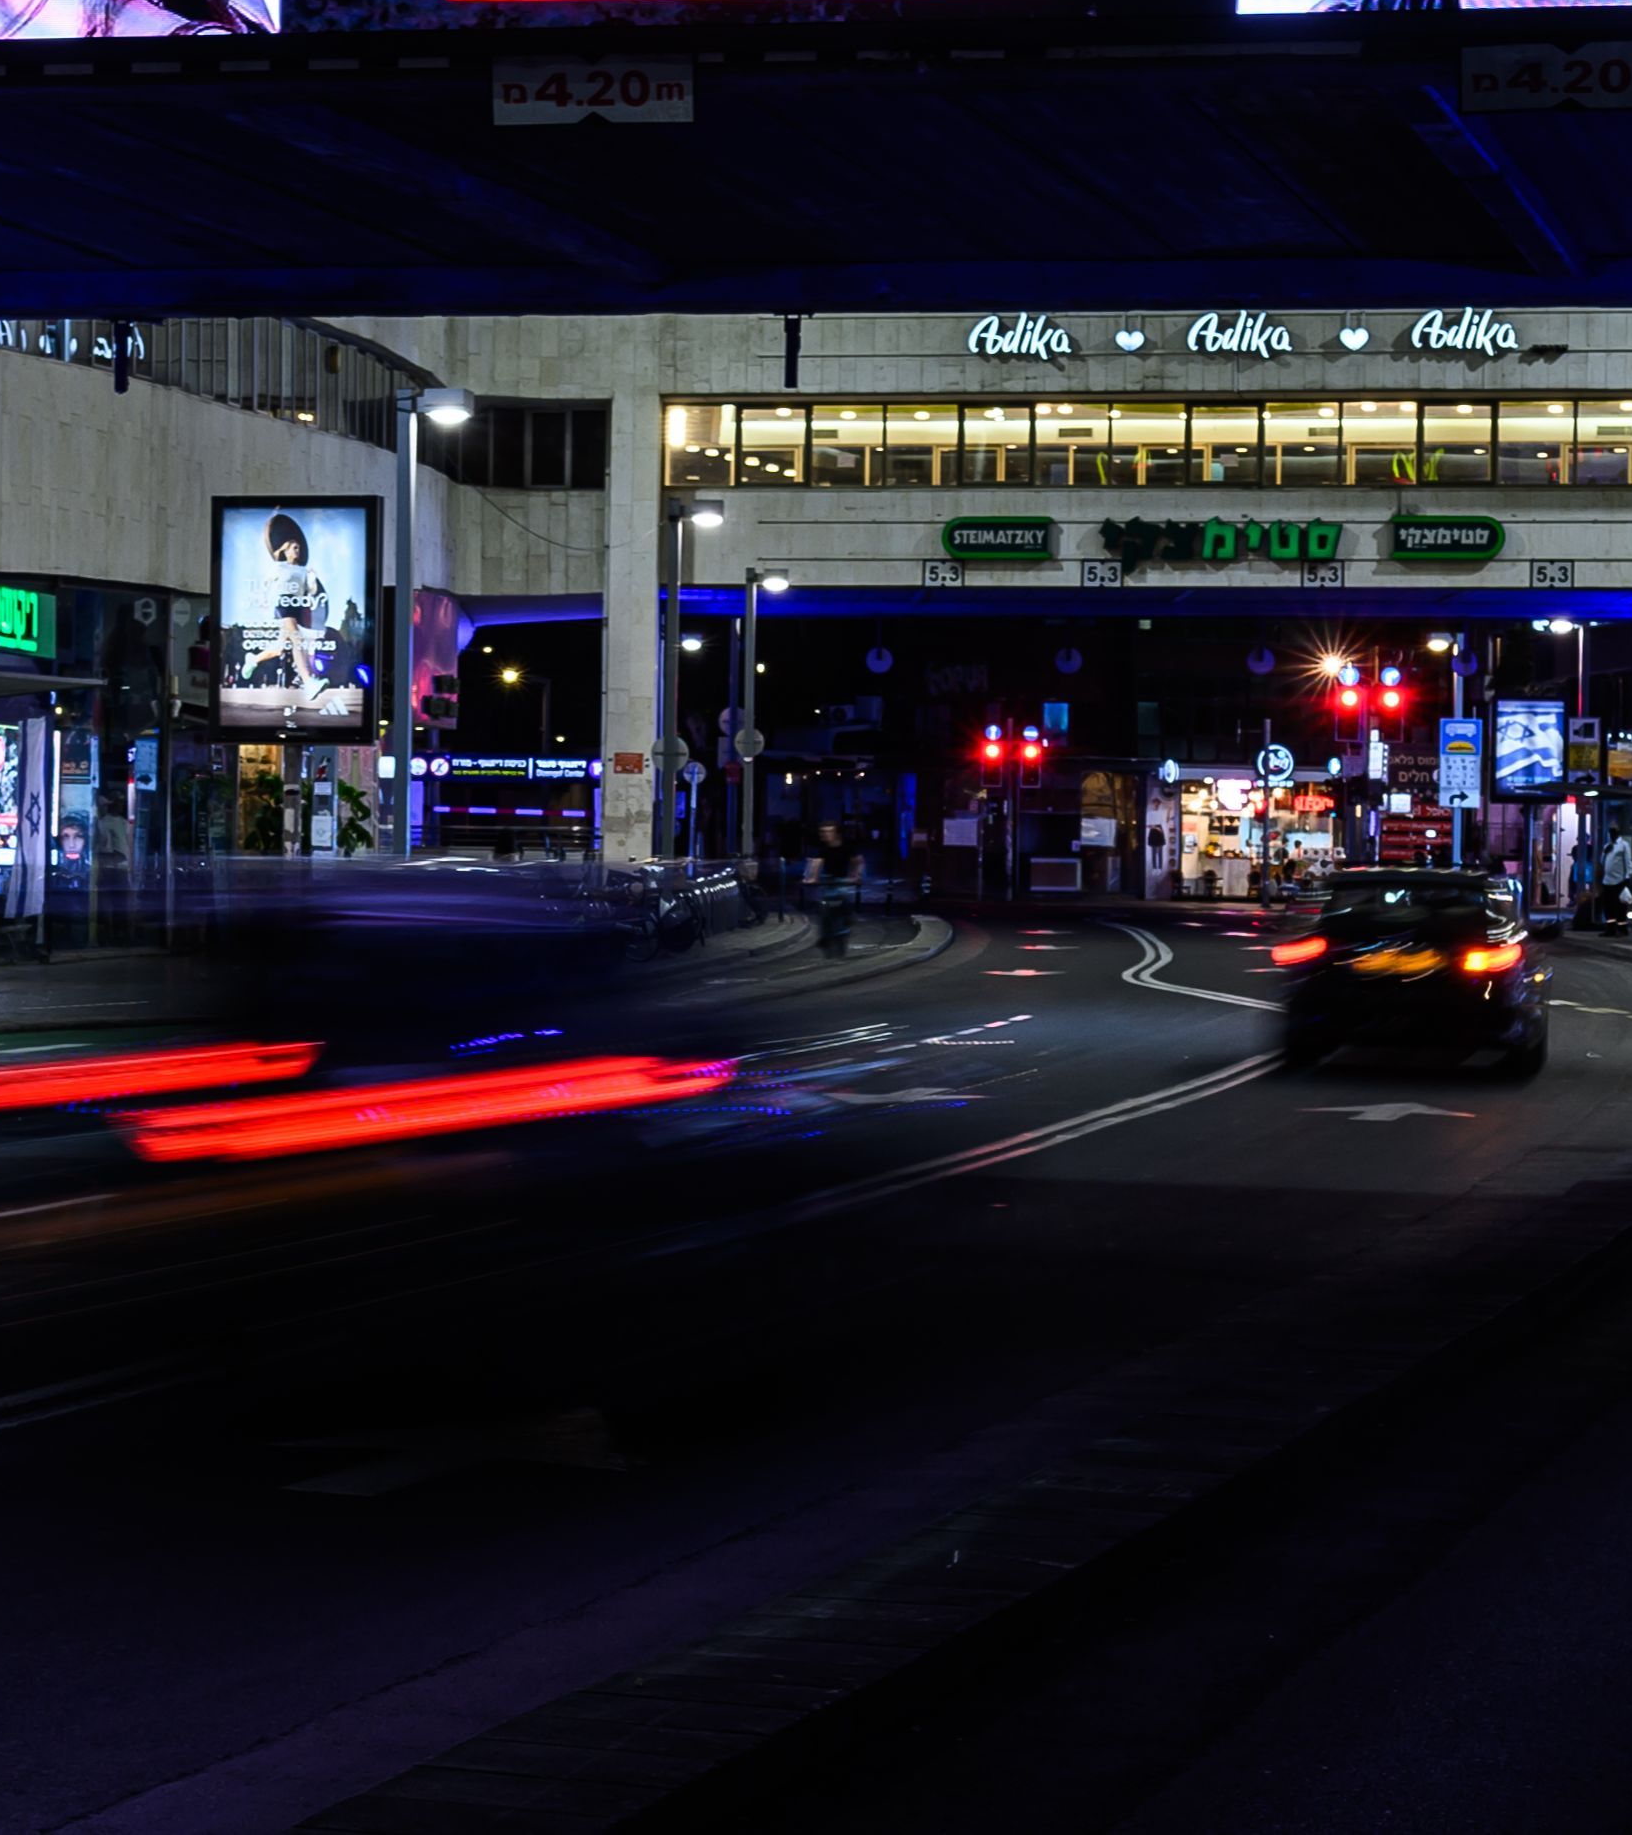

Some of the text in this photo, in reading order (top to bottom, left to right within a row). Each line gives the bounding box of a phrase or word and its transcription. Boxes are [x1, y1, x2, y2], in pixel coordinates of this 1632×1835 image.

[967, 306, 1519, 360] Adika Adika Adika
[952, 528, 1046, 546] STEIMATZKY
[1099, 517, 1342, 576] סטימצקי
[1398, 525, 1490, 549] סטימצקי
[928, 563, 961, 584] 5.3
[1086, 565, 1120, 584] 5.3
[1306, 565, 1339, 584] 5.3
[1536, 565, 1570, 584] 5.3
